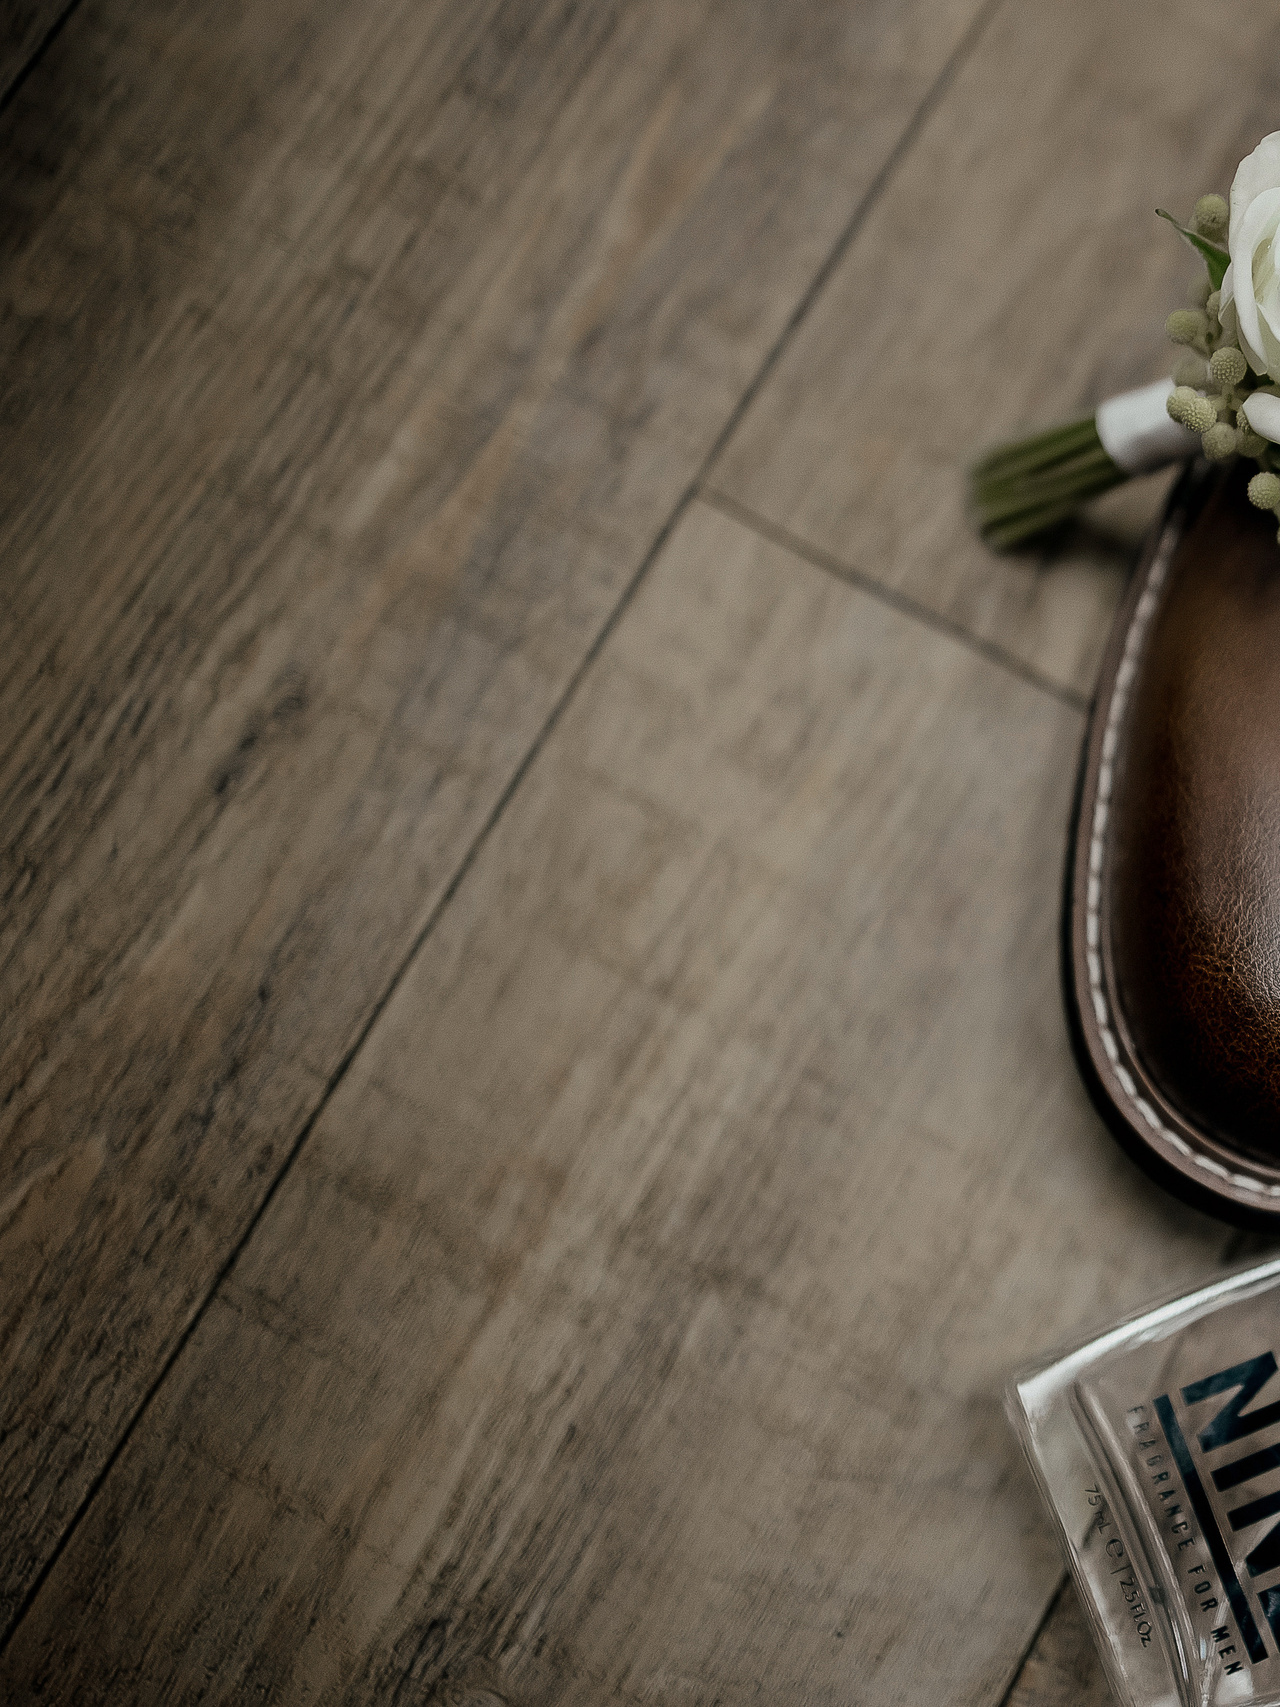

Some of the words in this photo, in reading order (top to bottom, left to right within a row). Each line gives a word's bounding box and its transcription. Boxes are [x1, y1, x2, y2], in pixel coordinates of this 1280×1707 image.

[1085, 1483, 1103, 1510] 75
[1127, 1405, 1196, 1550] FRAGRANCE
[1188, 1565, 1219, 1613] FOR
[1210, 1625, 1244, 1676] MEN
